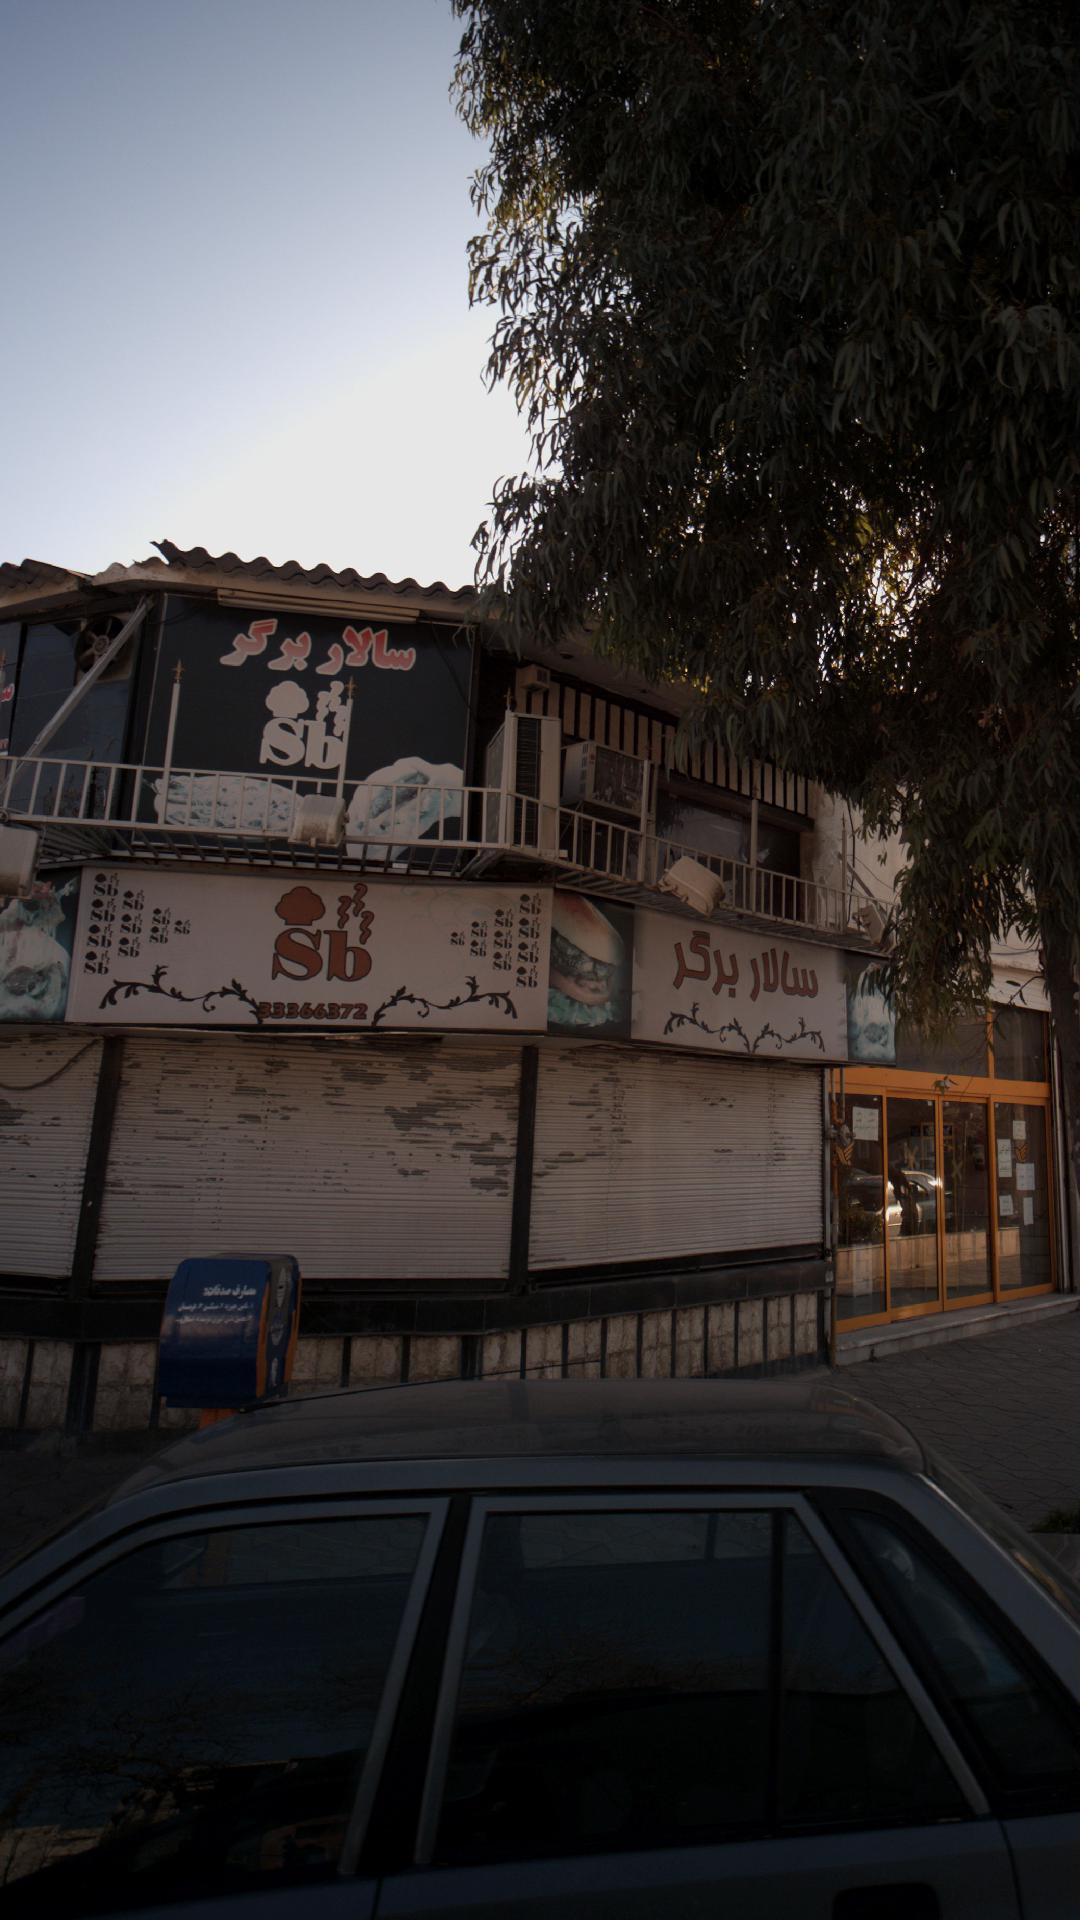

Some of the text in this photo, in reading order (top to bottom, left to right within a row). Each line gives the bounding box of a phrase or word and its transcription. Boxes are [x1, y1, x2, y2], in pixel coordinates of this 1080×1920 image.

[220, 618, 416, 675] سالار برگر
[259, 717, 346, 770] Sb
[93, 884, 118, 896] Sb
[122, 900, 143, 910] Sb
[520, 904, 541, 914] Sb
[91, 910, 115, 922] Sb
[495, 918, 513, 927] Sb
[120, 924, 141, 934] Sb
[519, 927, 539, 938] Sb
[87, 936, 111, 947] Sb
[150, 935, 168, 943] Sb
[494, 939, 512, 949] Sb
[118, 947, 139, 957] Sb
[272, 928, 371, 982] Sb
[518, 952, 538, 963] Sb
[84, 962, 108, 974] Sb
[493, 961, 511, 971] Sb
[673, 931, 819, 1001] سالار برگر
[516, 976, 537, 987] Sb
[258, 1002, 368, 1020] 33366372
